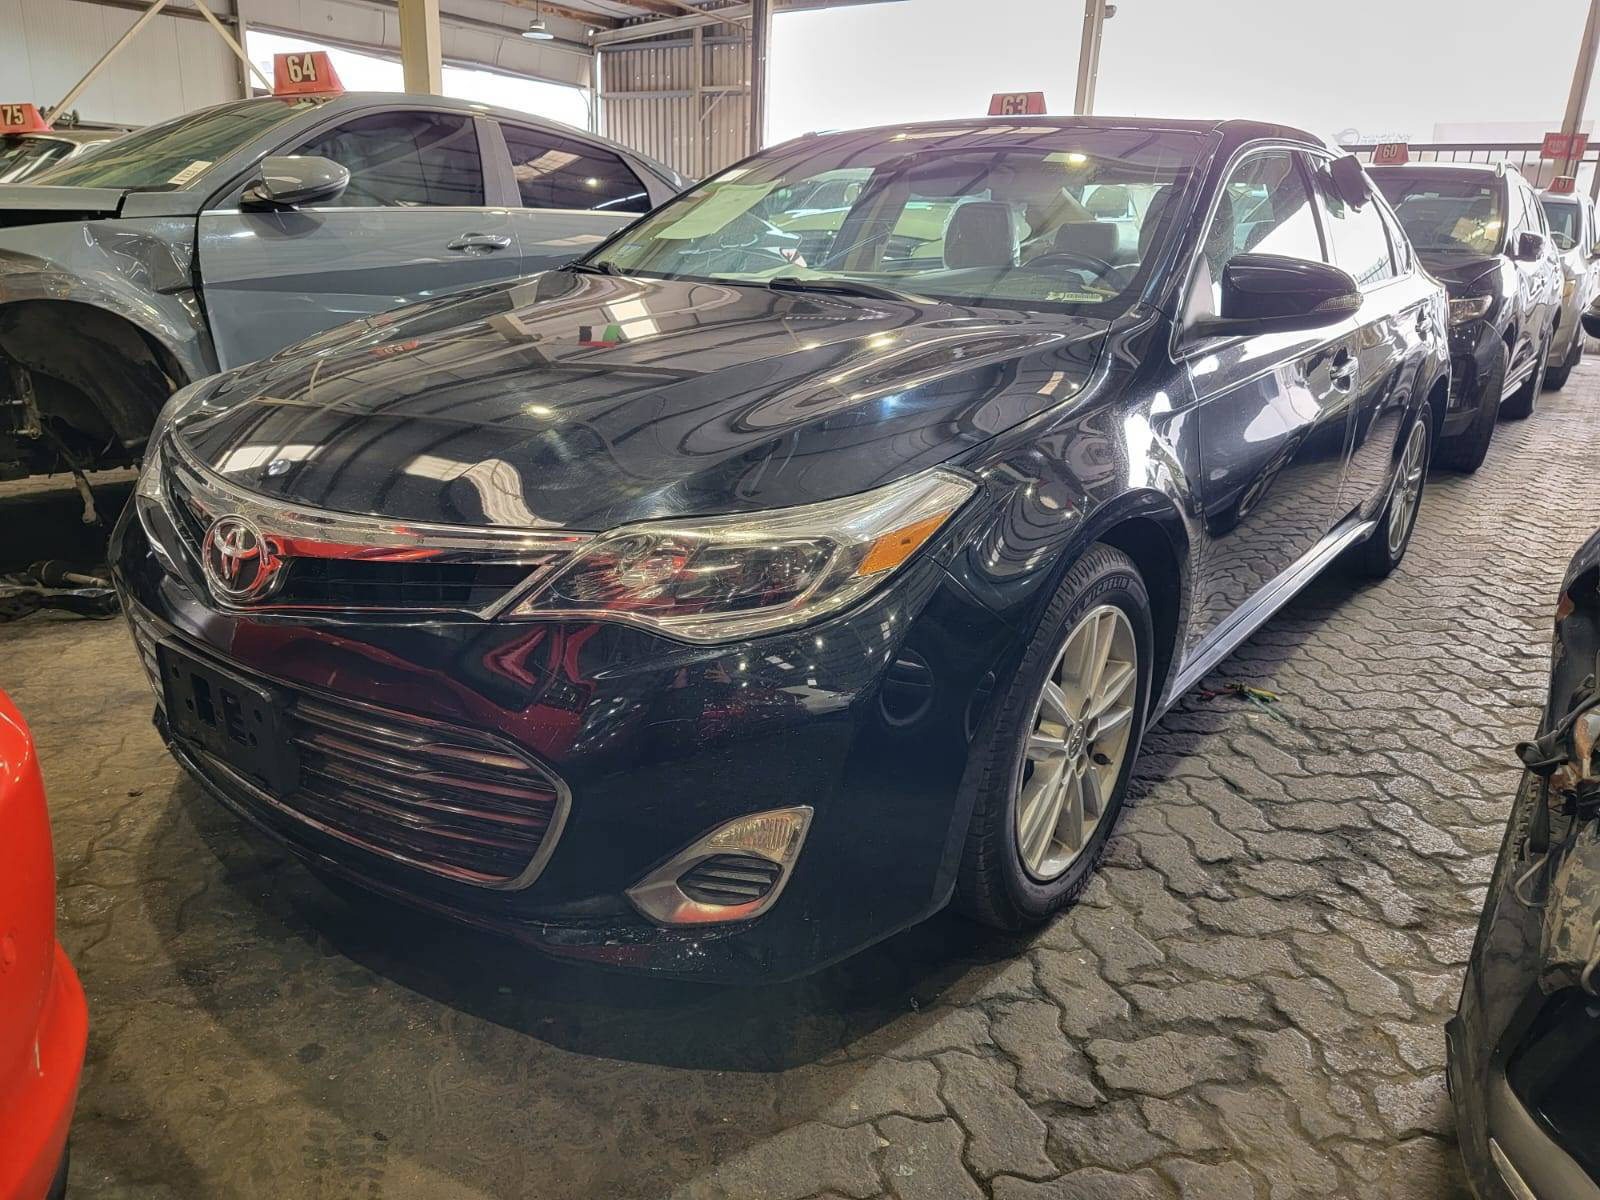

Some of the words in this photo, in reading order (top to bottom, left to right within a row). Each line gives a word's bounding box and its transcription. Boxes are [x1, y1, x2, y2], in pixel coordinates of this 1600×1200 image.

[286, 53, 317, 83] 64
[1001, 95, 1027, 114] 63
[2, 104, 24, 126] 75
[1382, 144, 1398, 158] 60
